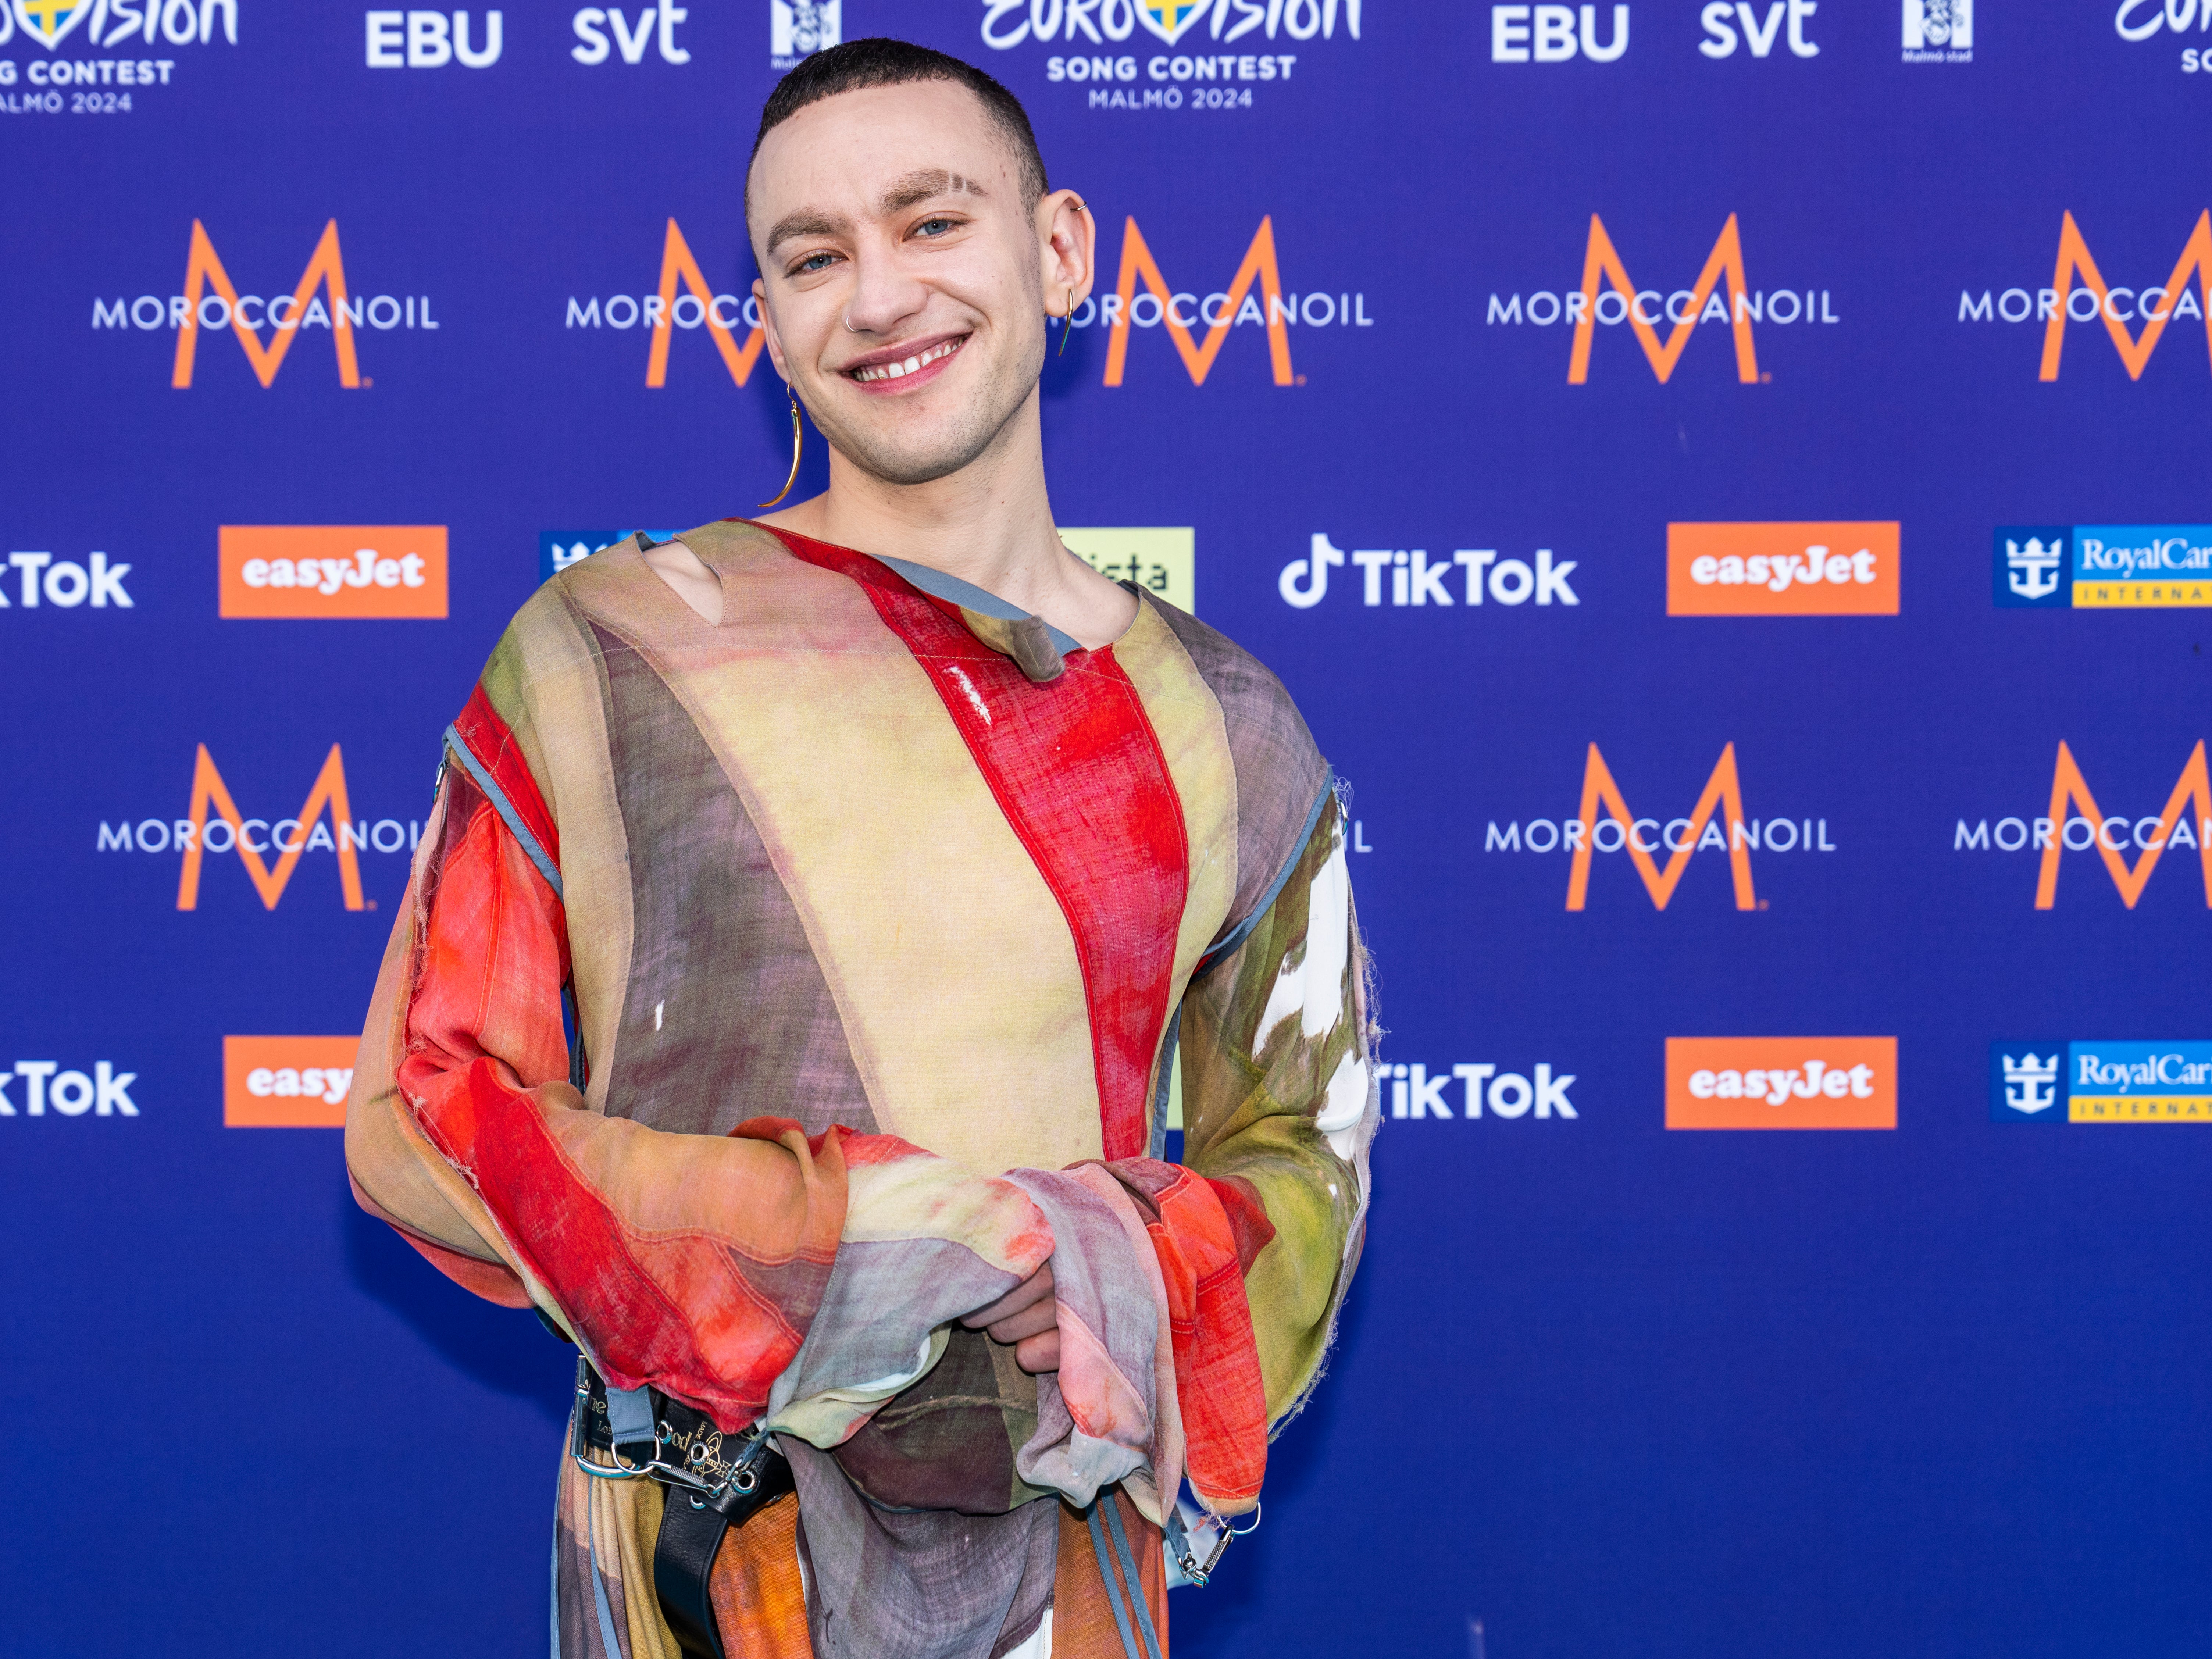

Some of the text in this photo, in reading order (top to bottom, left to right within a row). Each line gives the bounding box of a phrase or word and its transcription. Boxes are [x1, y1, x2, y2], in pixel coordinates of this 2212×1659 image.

[366, 11, 502, 68] EBU
[572, 0, 690, 65] svt
[1492, 5, 1629, 62] EBU
[1699, 0, 1819, 58] svt
[28, 60, 174, 85] CONTEST
[1047, 56, 1296, 81] SONG CONTEST
[72, 92, 132, 113] 2024
[1089, 86, 1252, 109] MALMÖ 2024
[91, 295, 440, 331] MOROCCANOIL
[1047, 292, 1374, 328] OROCCANOIL
[1487, 290, 1839, 325] MOROCCANOIL
[1957, 287, 2212, 323] MOROCCA
[242, 549, 425, 595] easyJet
[1352, 549, 1579, 606] TikTok
[1690, 545, 1876, 592] easyJet
[2084, 587, 2212, 601] INTERNA
[97, 818, 429, 852] MOROCCANOI
[1485, 818, 1837, 852] MOROCCANOIL
[246, 1067, 353, 1105] easy
[1688, 1060, 1874, 1106] easyJet
[2079, 1054, 2212, 1093] RoyalCar
[696, 1421, 707, 1439] MADE
